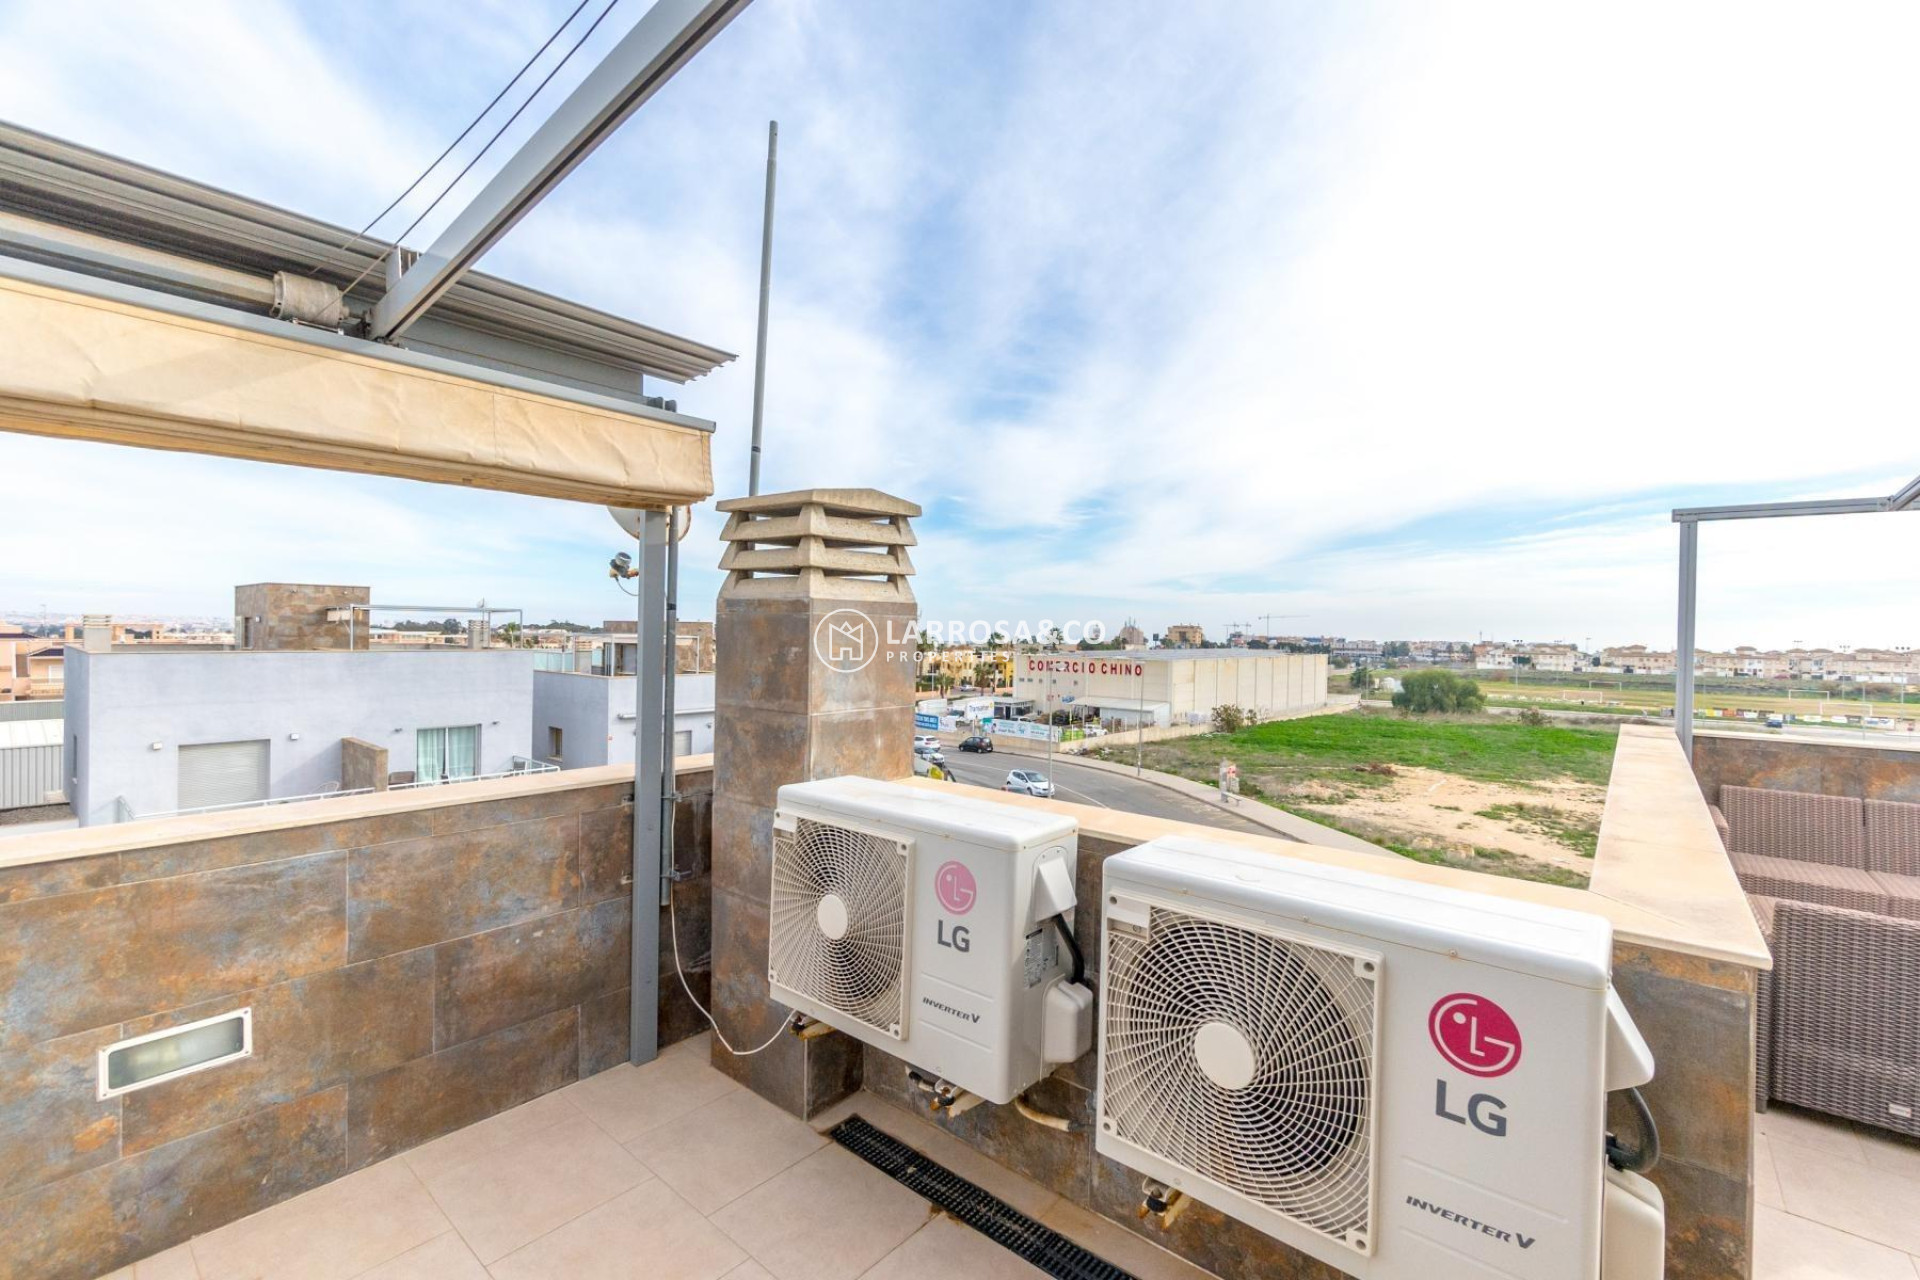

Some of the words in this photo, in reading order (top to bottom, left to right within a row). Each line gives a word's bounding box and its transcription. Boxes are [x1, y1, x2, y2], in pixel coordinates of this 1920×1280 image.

[1101, 662, 1142, 676] CHINO
[937, 919, 971, 953] LG
[922, 996, 970, 1020] INVERTER
[971, 1013, 981, 1023] V
[1435, 1078, 1507, 1137] LG
[1405, 1195, 1512, 1242] INVERTER
[1515, 1232, 1536, 1249] V
